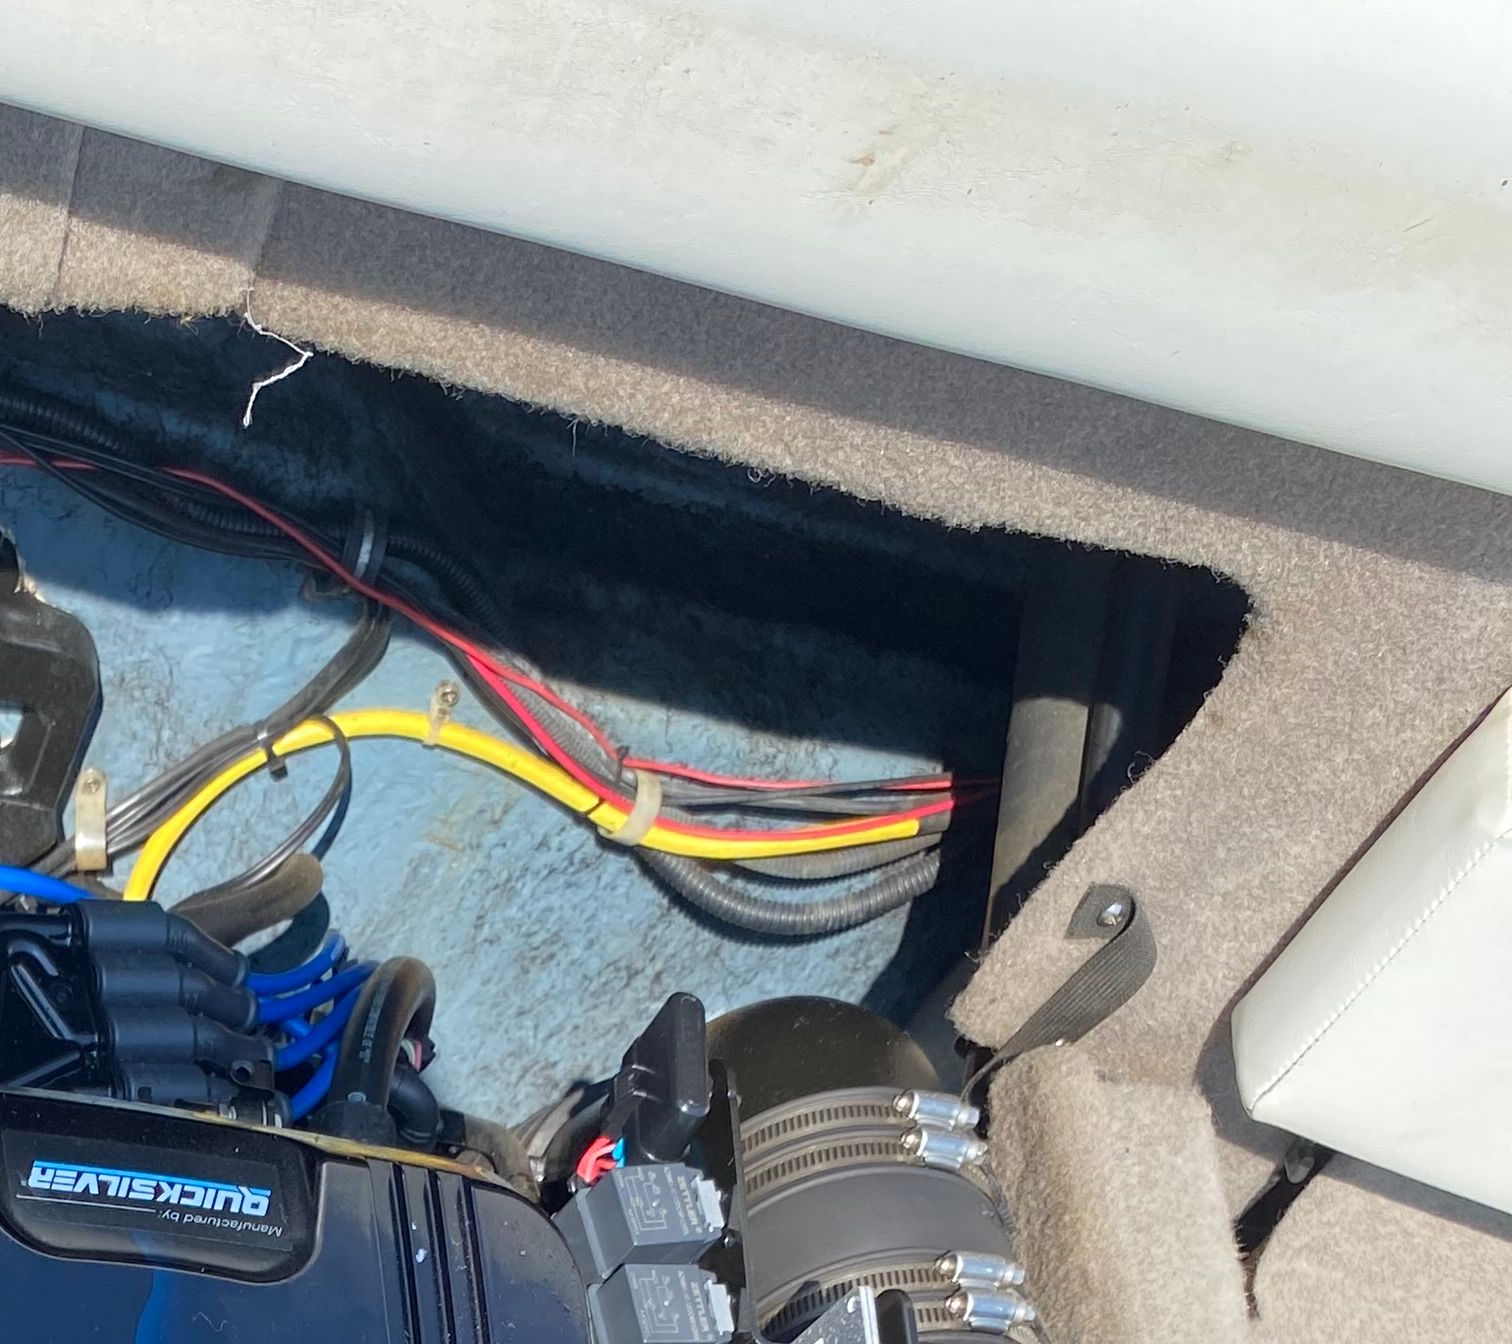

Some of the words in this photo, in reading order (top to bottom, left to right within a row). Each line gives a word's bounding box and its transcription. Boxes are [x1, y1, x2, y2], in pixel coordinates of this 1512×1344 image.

[28, 1163, 271, 1217] QUICKSILVER
[677, 1176, 698, 1225] ZETTLER
[183, 1213, 283, 1237] Manufactured
[691, 1282, 709, 1332] ZETTLER
